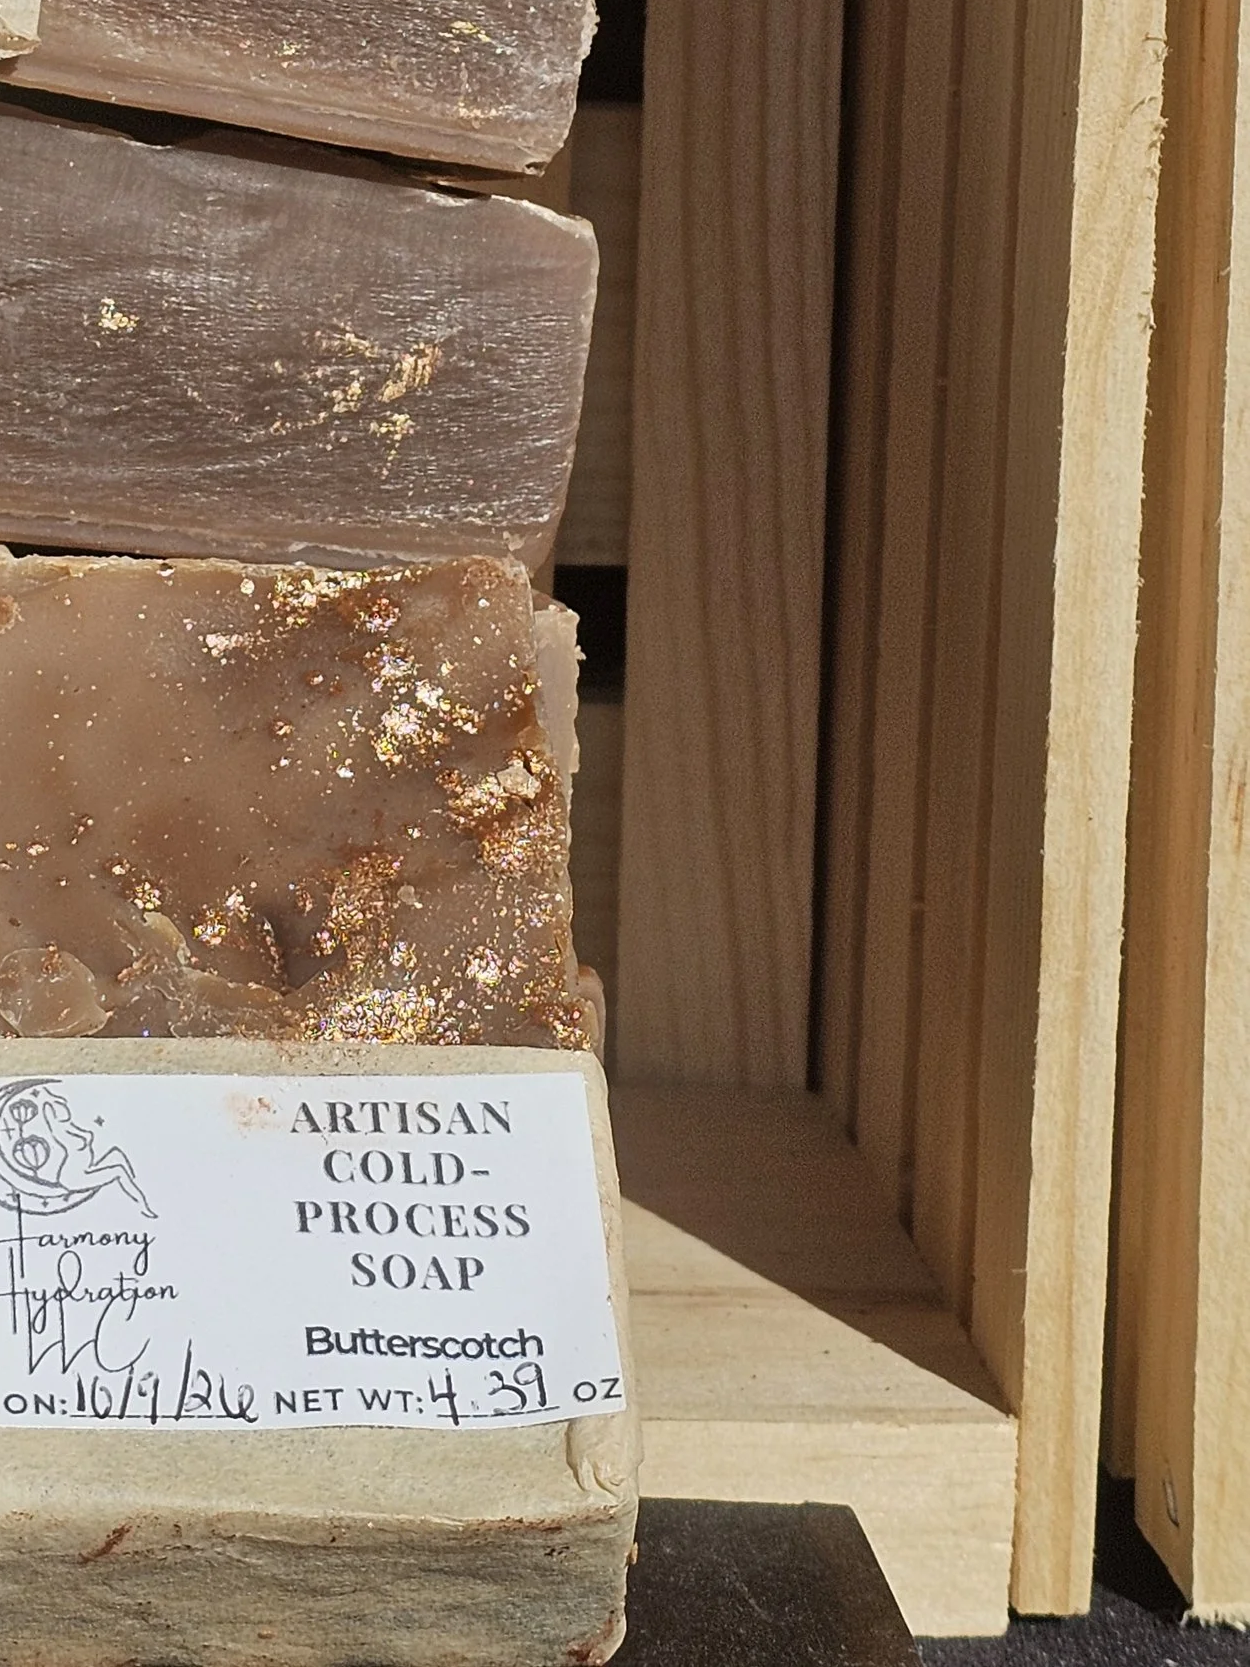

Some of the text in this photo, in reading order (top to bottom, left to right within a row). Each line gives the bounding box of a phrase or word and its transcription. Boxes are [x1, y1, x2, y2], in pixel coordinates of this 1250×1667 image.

[290, 1099, 513, 1137] ARTISAN
[322, 1149, 492, 1186] COLD-
[293, 1199, 532, 1238] PROCESS
[350, 1252, 485, 1292] SOAP
[305, 1326, 544, 1359] Butterscotch
[3, 1393, 67, 1415] ON:
[275, 1389, 343, 1414] NET
[357, 1388, 424, 1414] WT:
[573, 1378, 622, 1403] OZ
